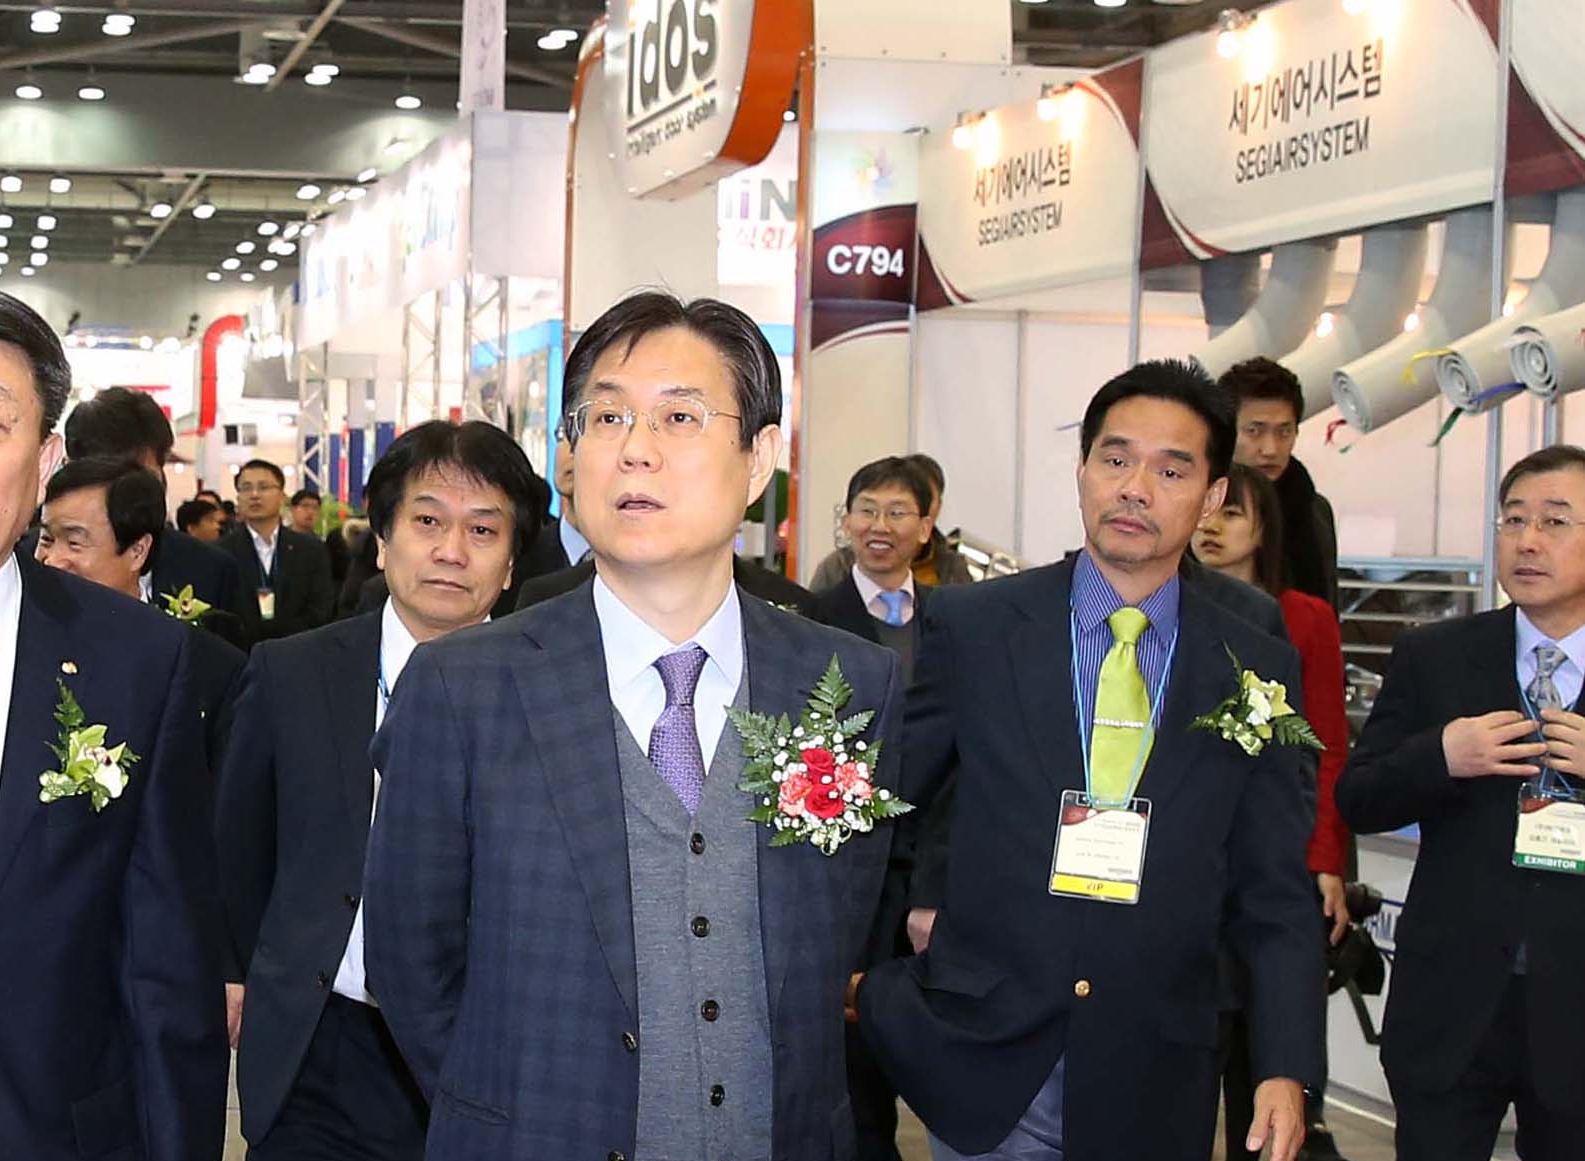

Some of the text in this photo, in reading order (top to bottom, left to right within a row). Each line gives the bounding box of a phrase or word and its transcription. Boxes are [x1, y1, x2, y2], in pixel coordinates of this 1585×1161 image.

[1228, 37, 1383, 135] 세기에어시스템
[974, 143, 1071, 207] 세기에어시스템
[1235, 115, 1370, 184] SEGIAIRSYSTEM
[827, 244, 904, 278] C794
[1086, 882, 1104, 892] VIP
